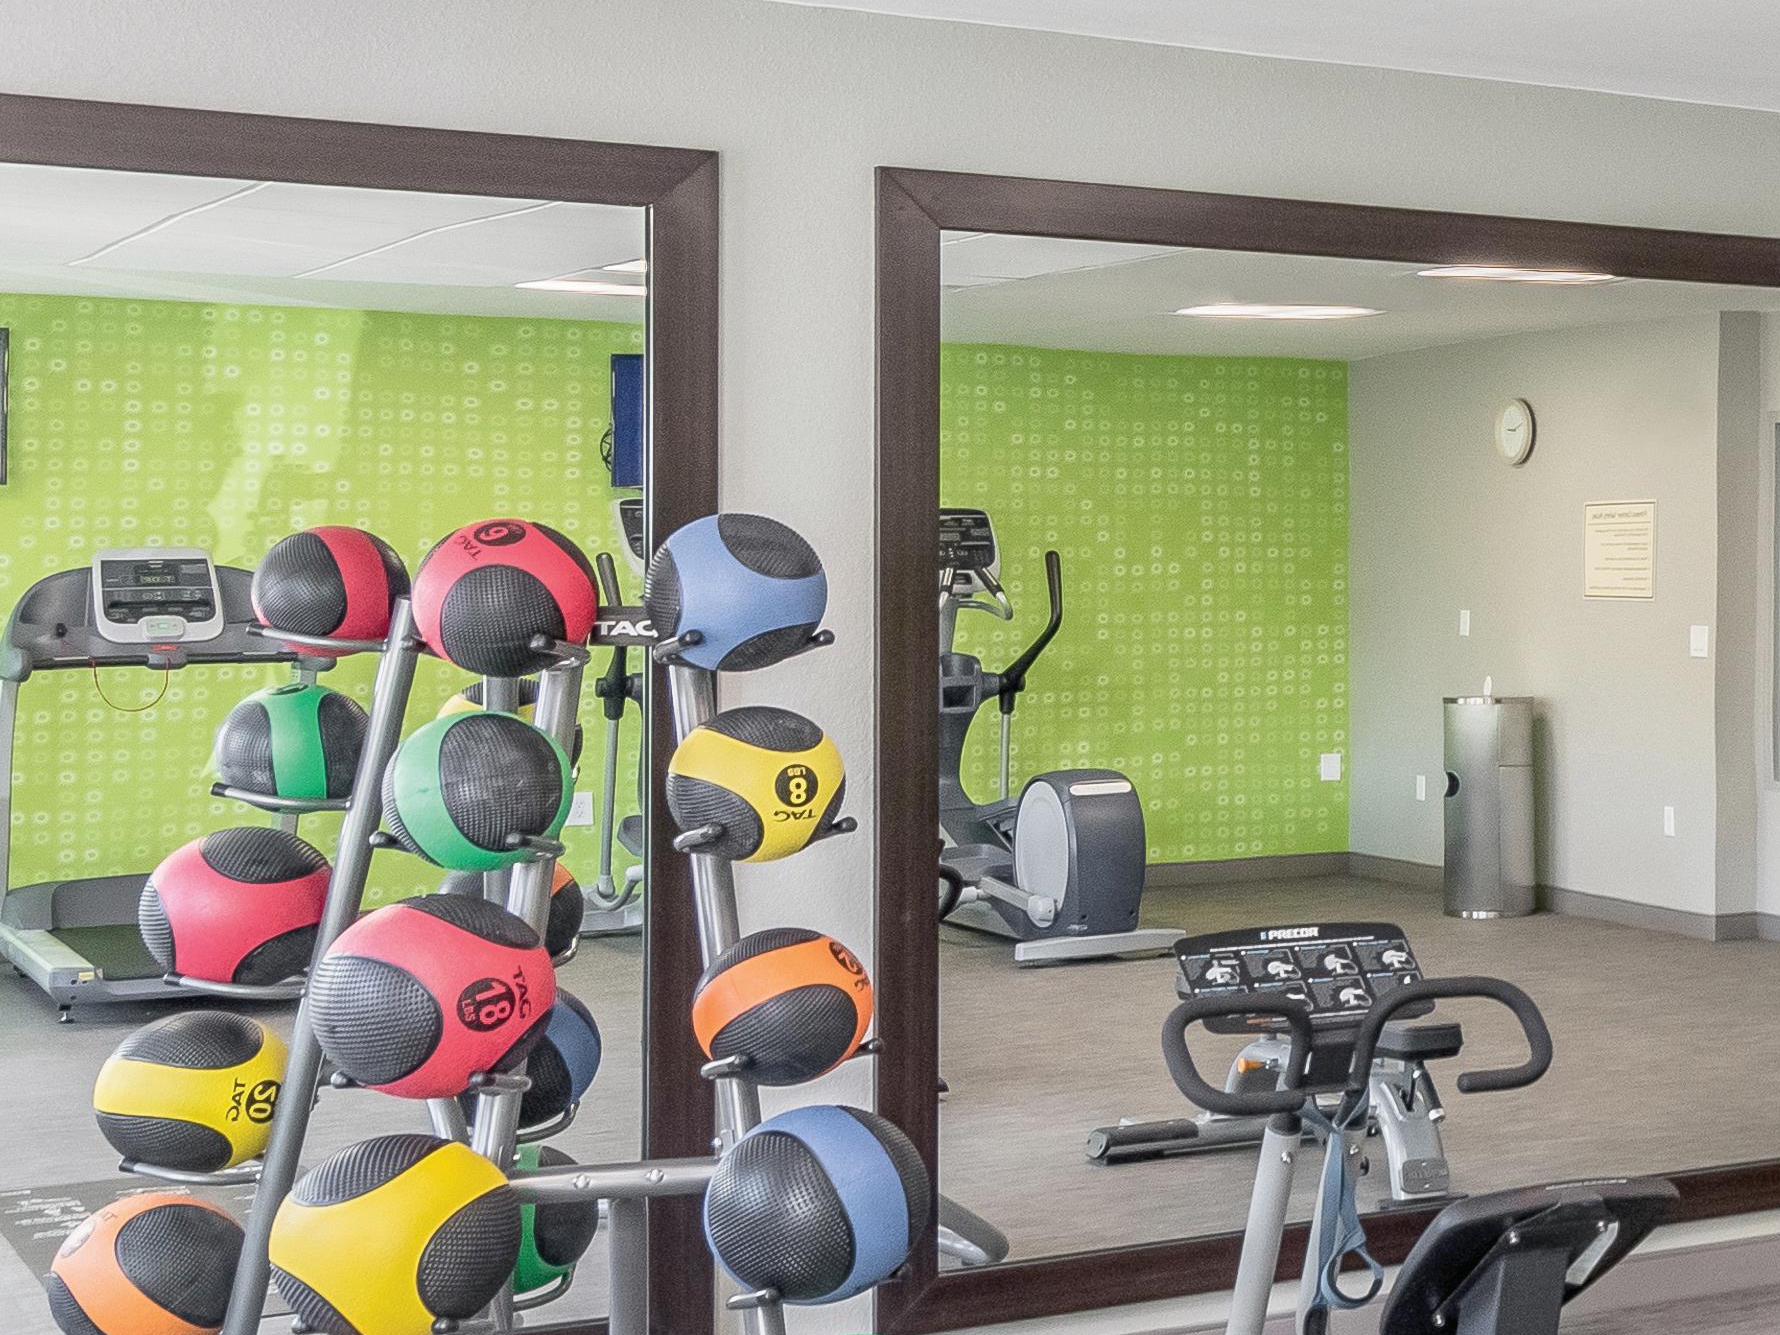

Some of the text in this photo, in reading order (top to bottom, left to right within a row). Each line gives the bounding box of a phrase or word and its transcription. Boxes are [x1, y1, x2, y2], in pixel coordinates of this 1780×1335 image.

[453, 535, 482, 561] TAG
[594, 619, 659, 638] TAG
[787, 767, 806, 777] LBS
[789, 777, 807, 804] 8
[773, 809, 816, 822] TAG
[1268, 927, 1319, 940] PRECOR
[513, 965, 531, 1018] TAG
[462, 1000, 476, 1022] LBS
[475, 982, 510, 1025] 18
